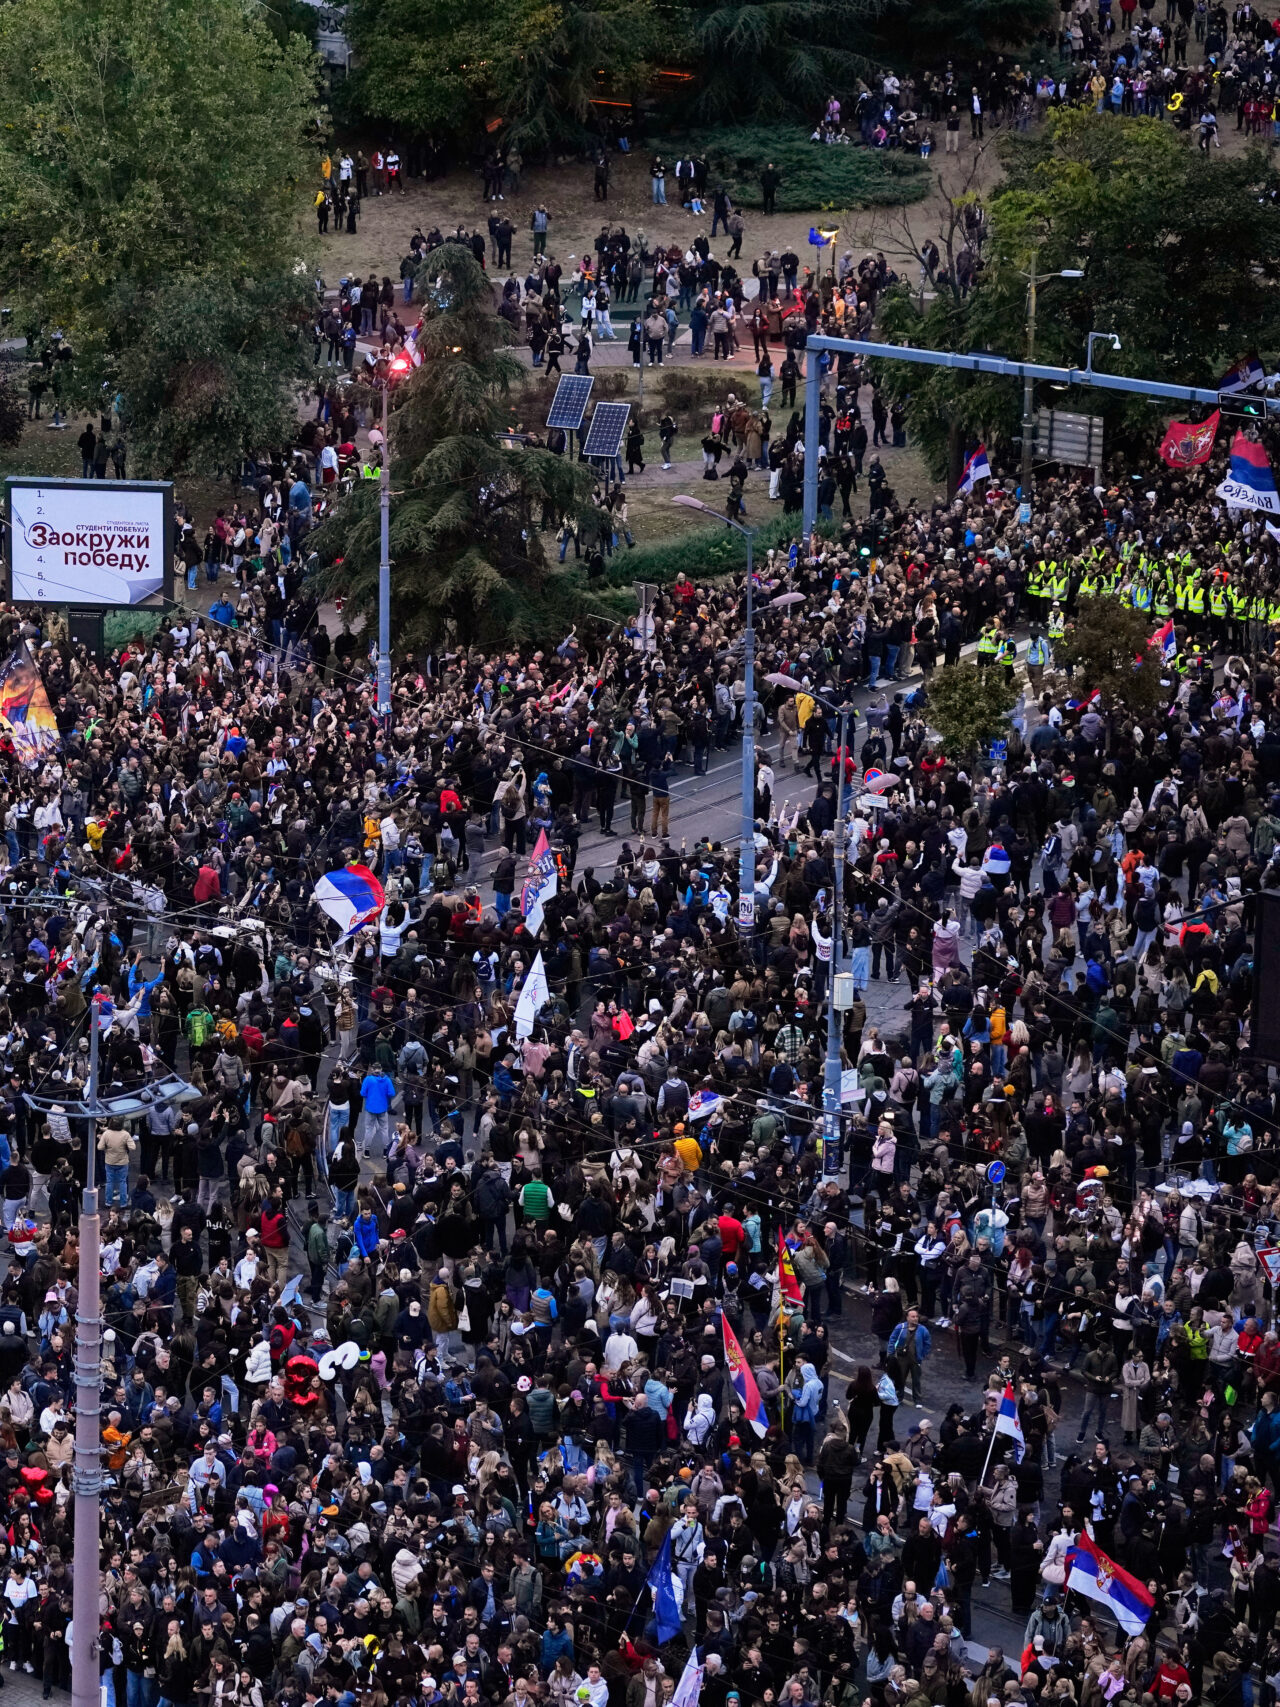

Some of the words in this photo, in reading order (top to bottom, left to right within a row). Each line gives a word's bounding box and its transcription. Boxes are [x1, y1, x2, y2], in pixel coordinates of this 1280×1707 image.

[37, 490, 45, 498] 1.
[36, 507, 45, 515] 2.
[113, 525, 149, 533] ПОБЕЂУЈУ
[32, 525, 150, 553] Заокружи
[37, 555, 46, 563] 4.
[64, 550, 150, 573] победу.
[37, 572, 46, 580] 5.
[37, 589, 46, 597] 6.
